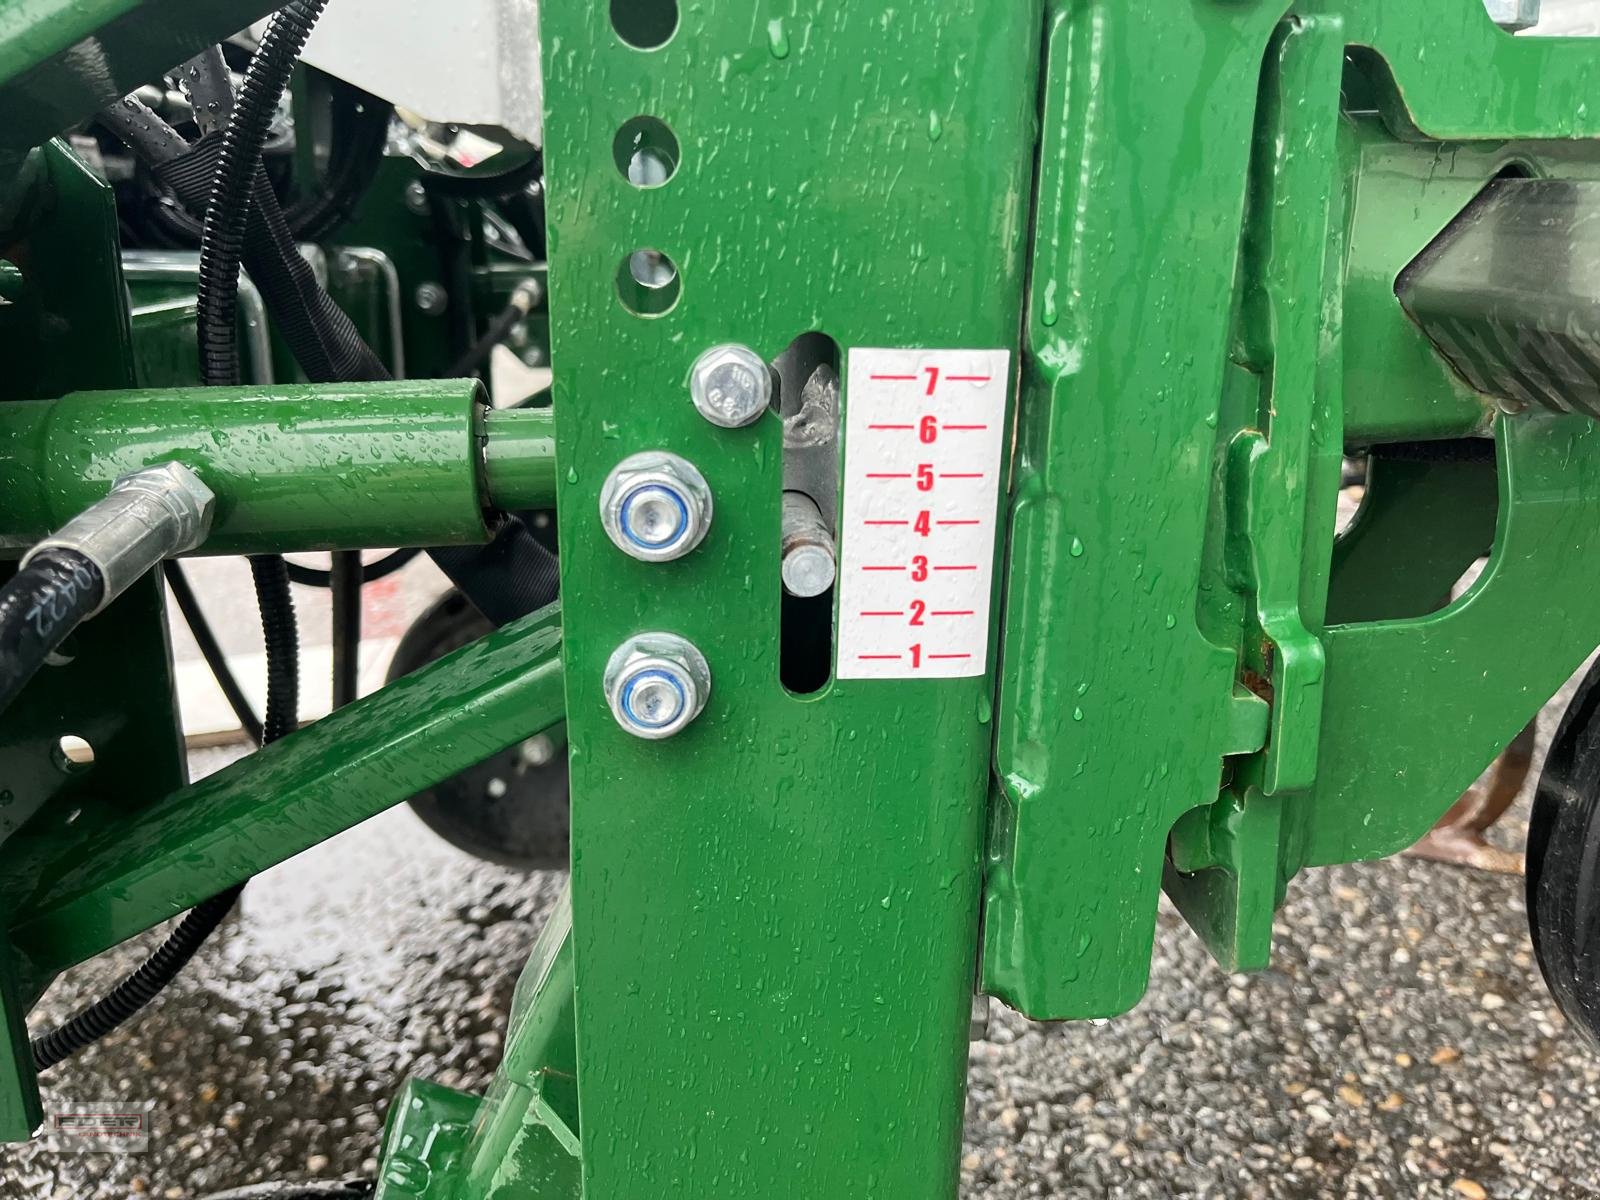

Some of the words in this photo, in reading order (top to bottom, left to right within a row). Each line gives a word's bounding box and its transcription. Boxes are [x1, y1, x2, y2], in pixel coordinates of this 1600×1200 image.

[924, 367, 940, 396] 7
[919, 415, 937, 444] 6
[916, 464, 934, 492] 5
[913, 510, 931, 537] 4
[911, 555, 928, 582] 3
[908, 599, 926, 626] 2
[909, 643, 921, 668] 1
